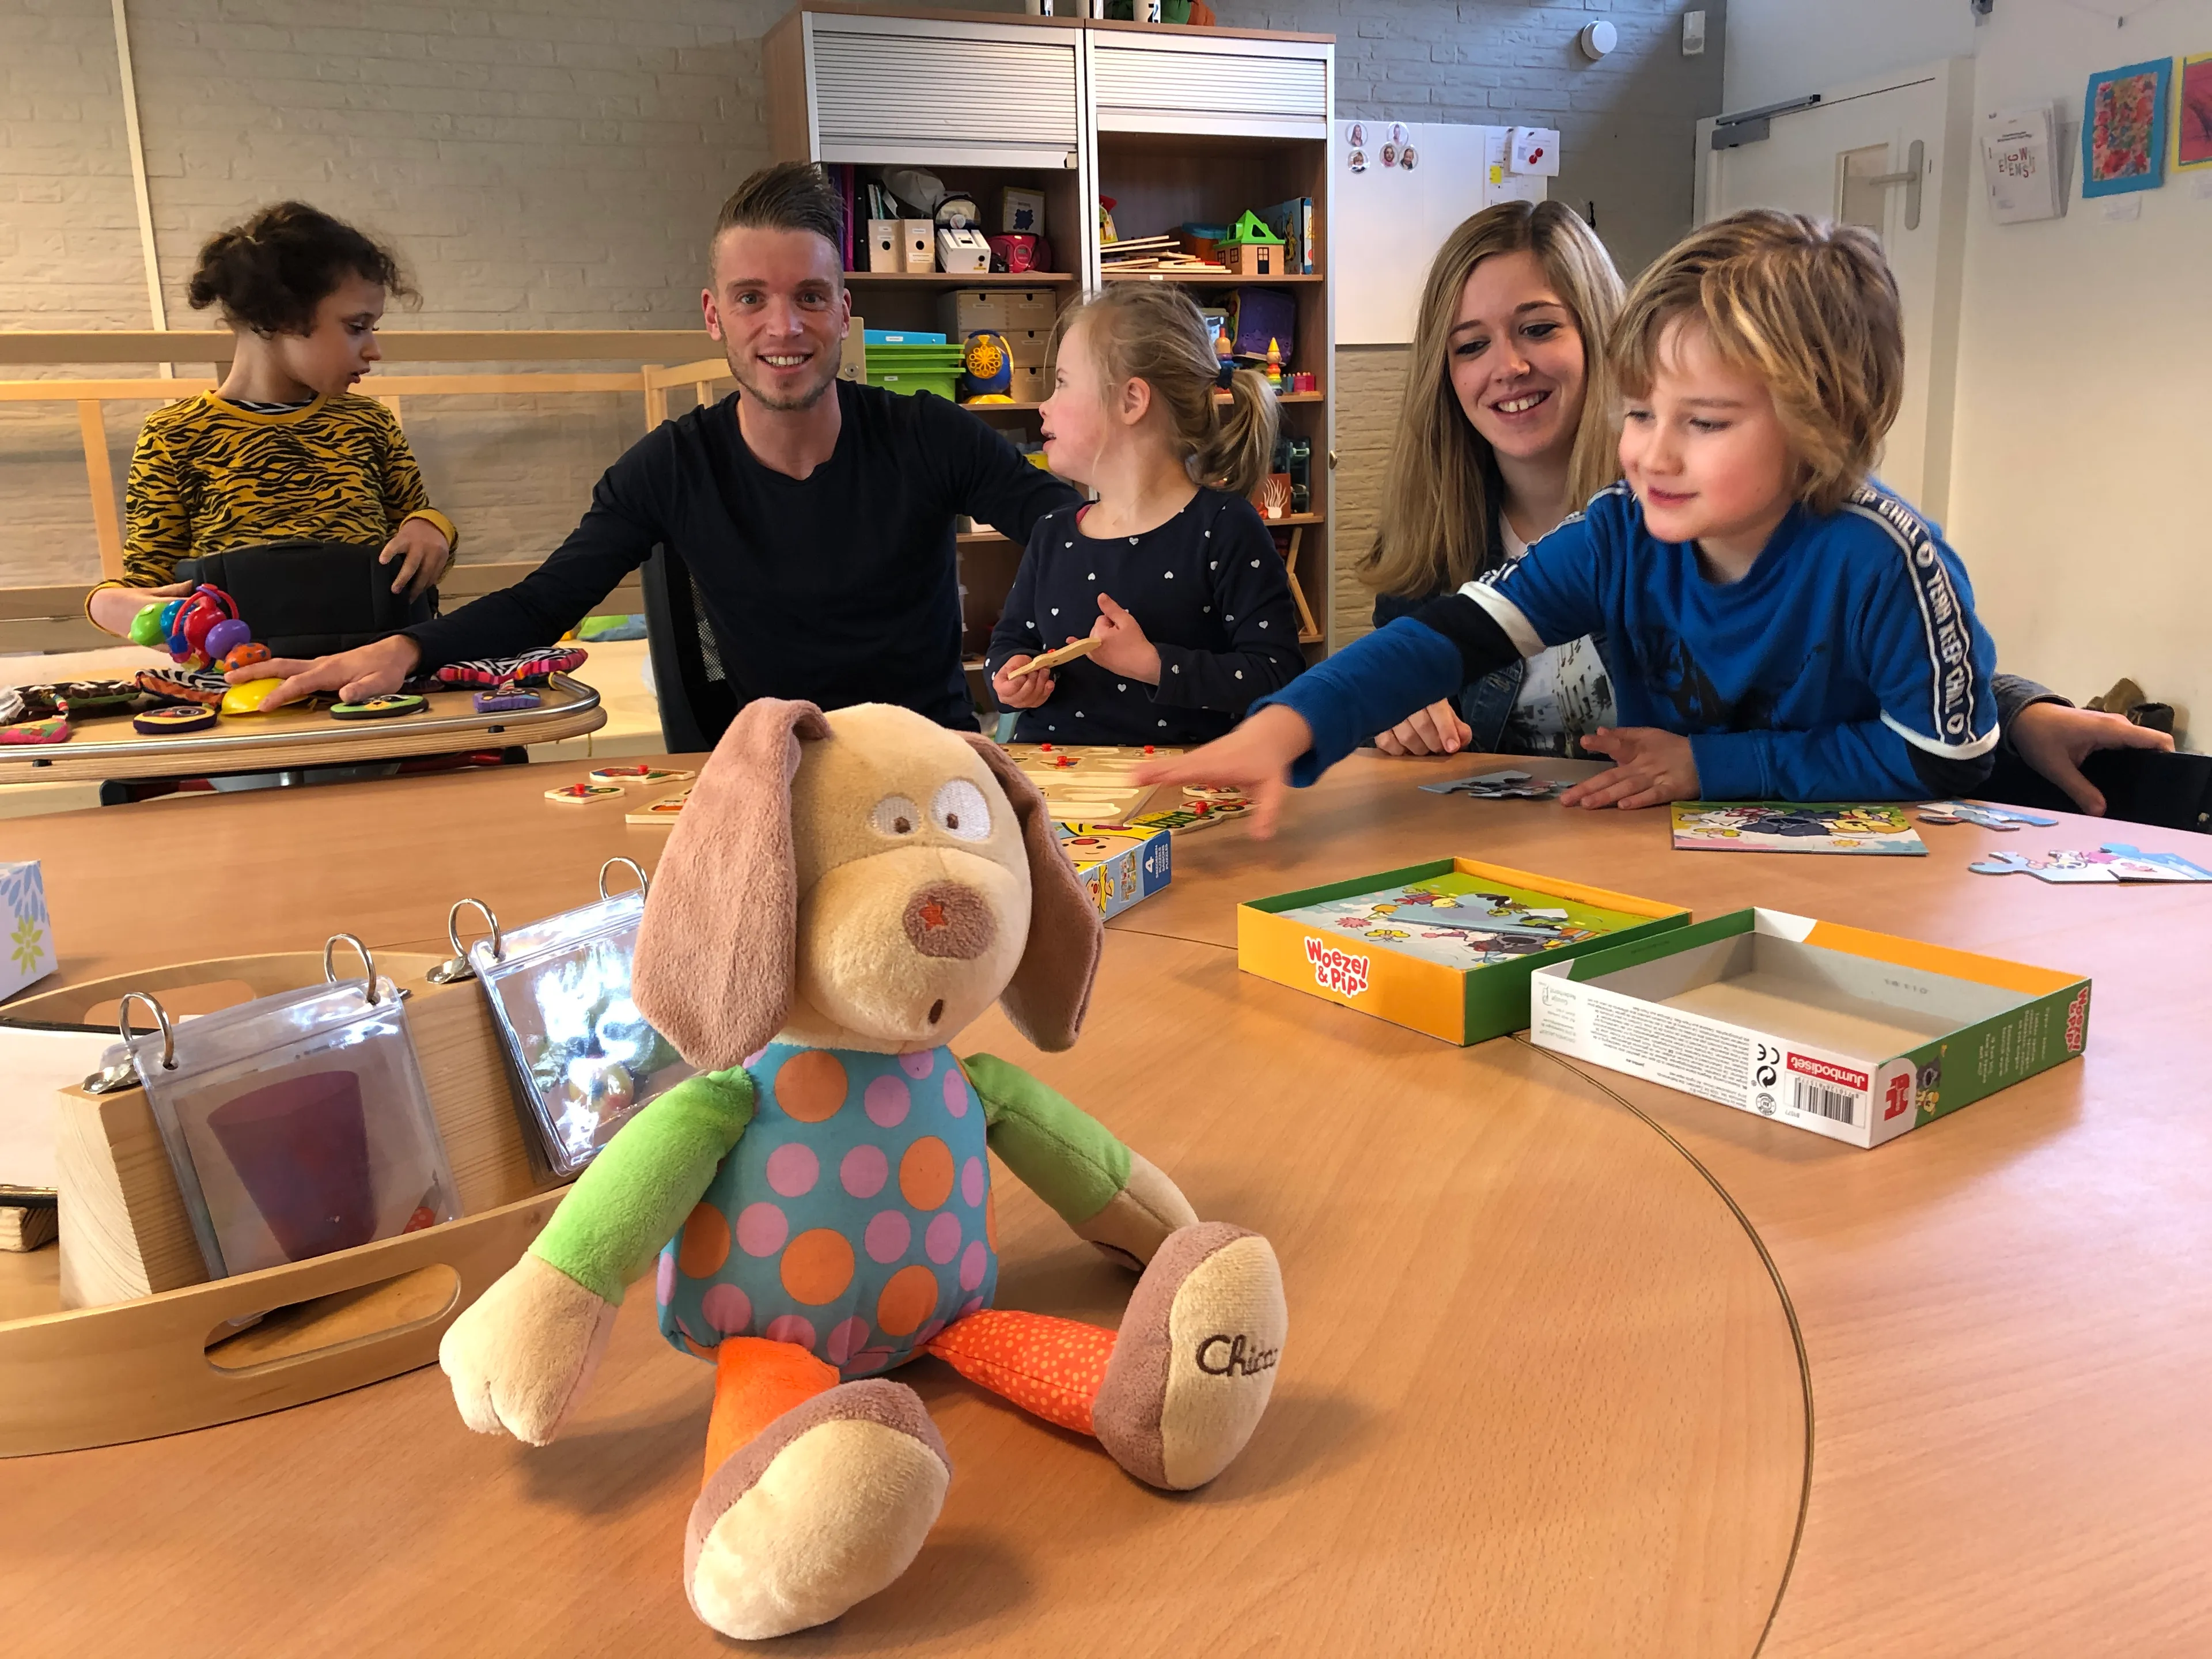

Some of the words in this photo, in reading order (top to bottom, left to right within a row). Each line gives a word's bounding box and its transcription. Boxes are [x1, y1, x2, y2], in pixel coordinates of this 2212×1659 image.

[1878, 498, 1921, 548] CHILL
[1938, 619, 1964, 666] KEEP
[1945, 665, 1965, 714] CHILL
[1145, 856, 1154, 873] 4
[1306, 939, 1368, 979] Woezel
[1318, 965, 1328, 984] &
[1330, 968, 1358, 996] Pip
[1790, 1056, 1865, 1088] Jumbodiset
